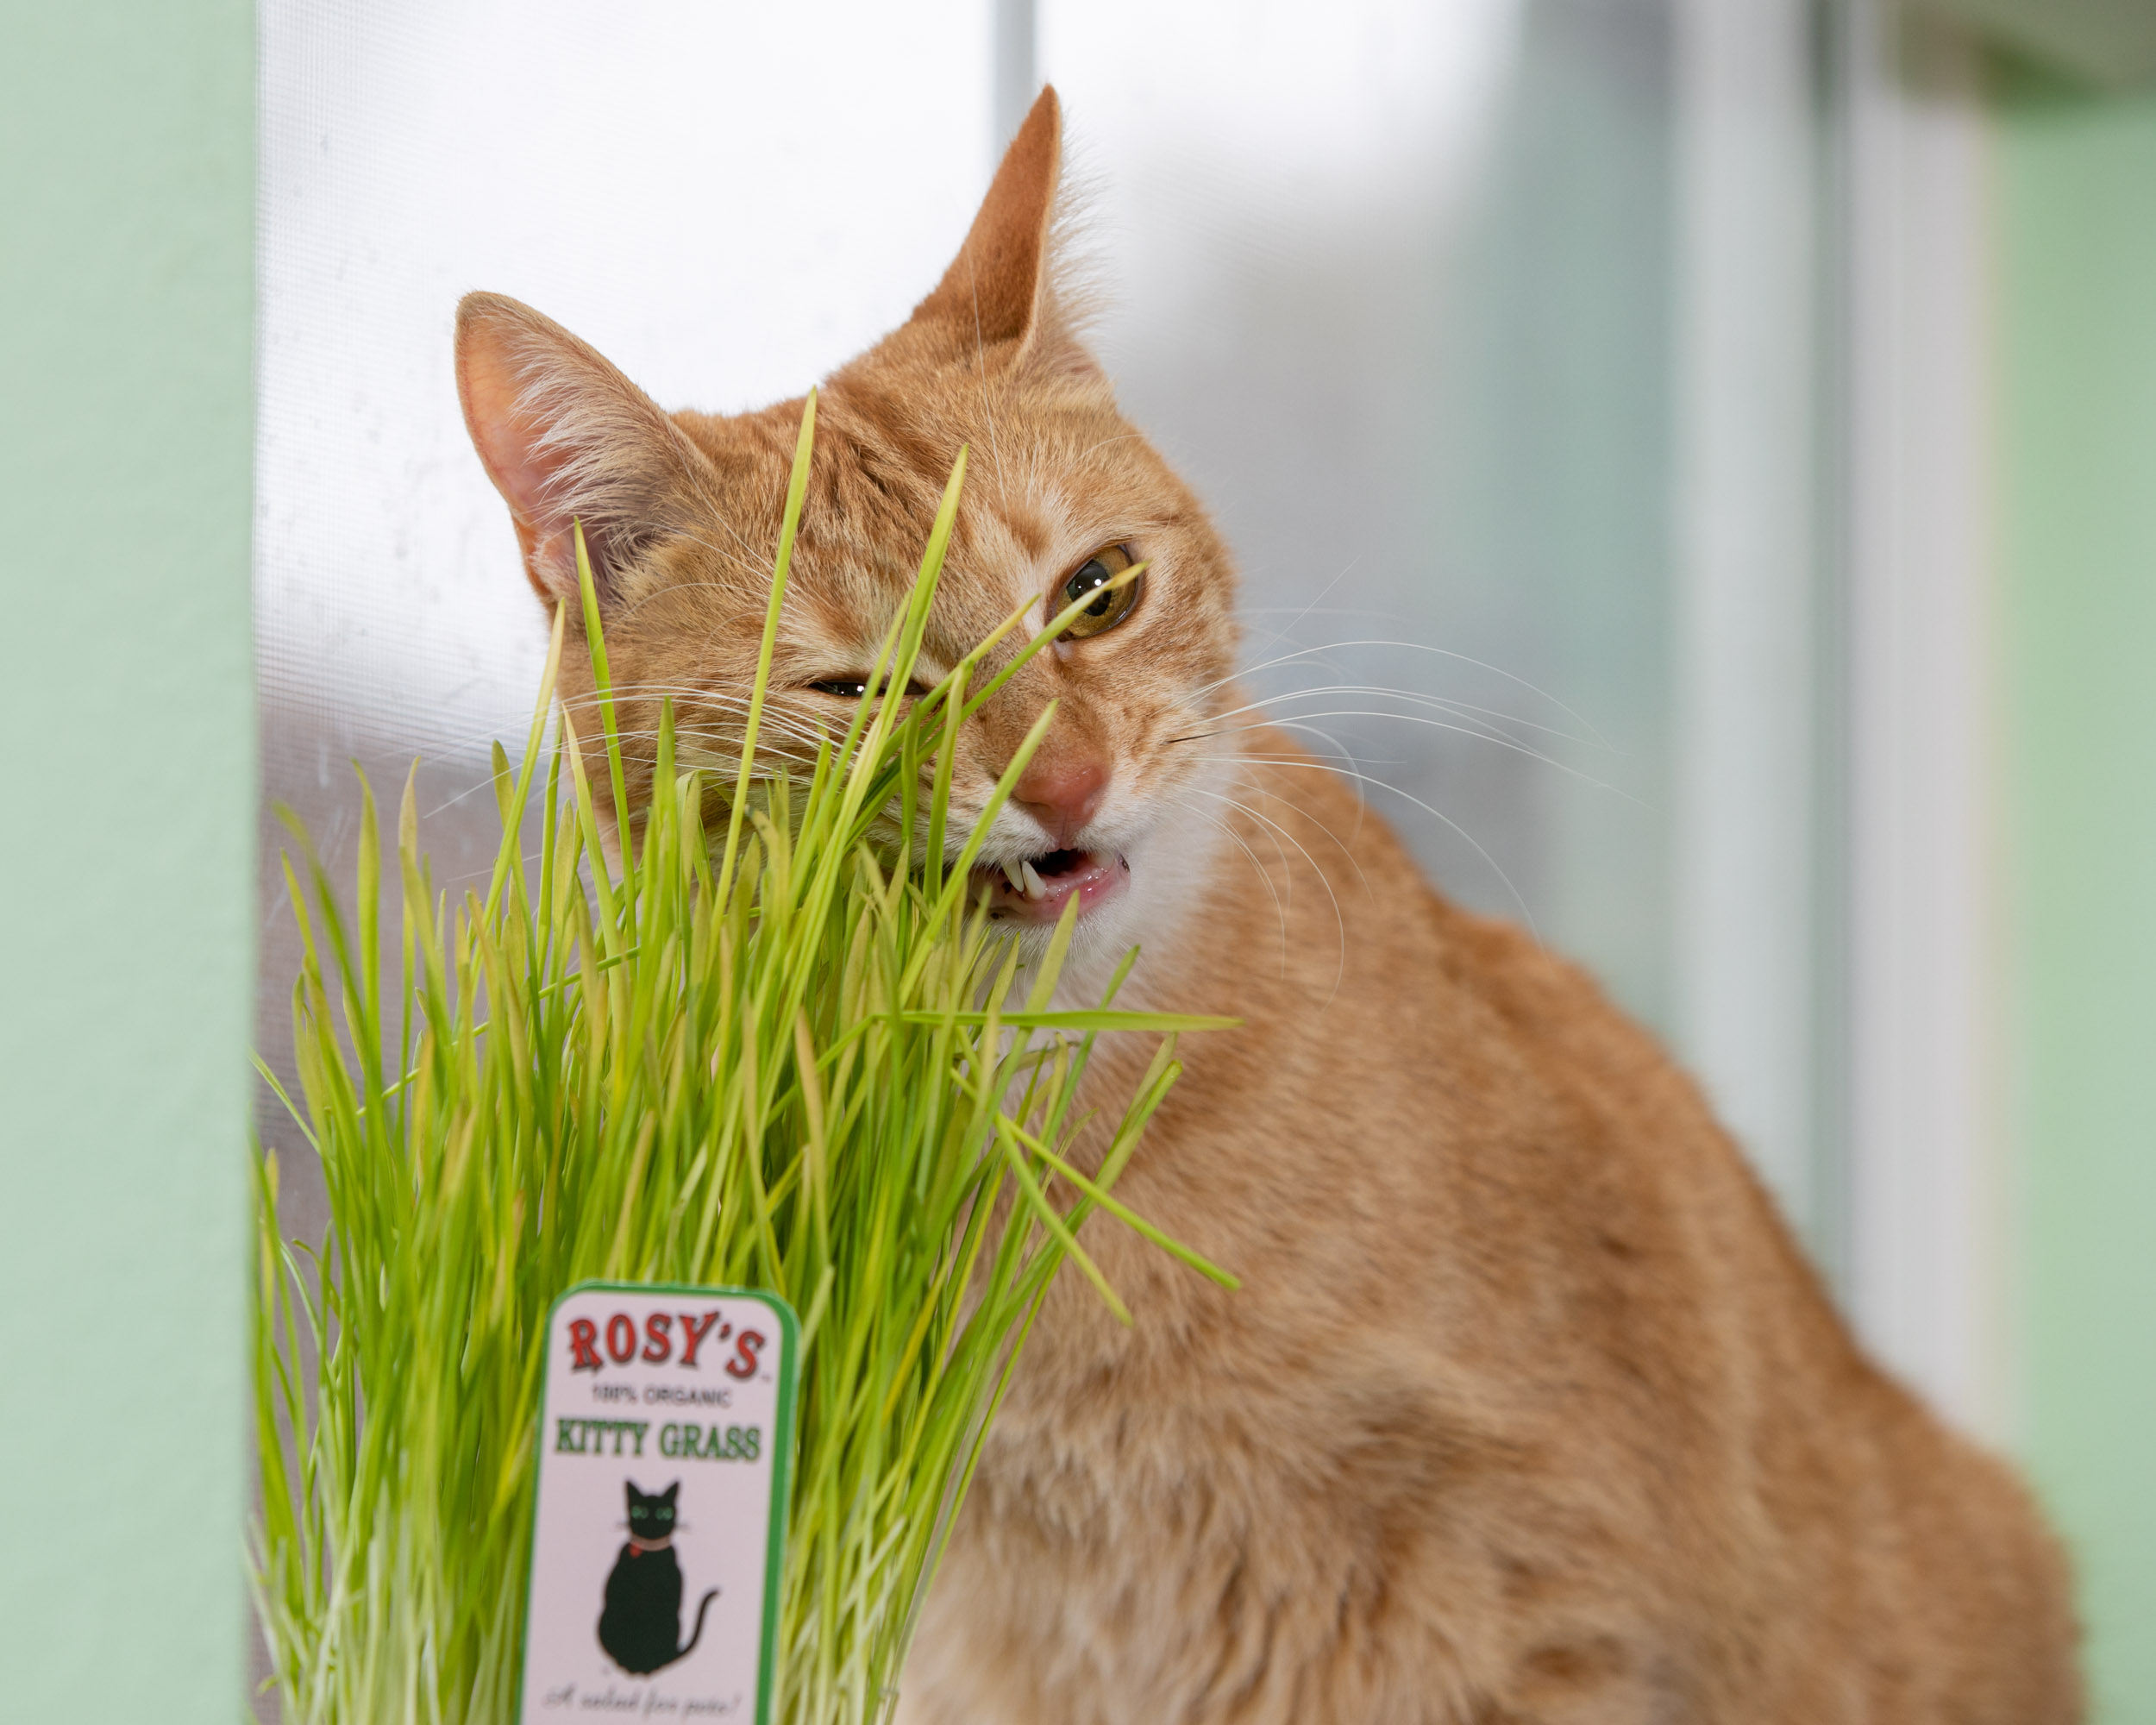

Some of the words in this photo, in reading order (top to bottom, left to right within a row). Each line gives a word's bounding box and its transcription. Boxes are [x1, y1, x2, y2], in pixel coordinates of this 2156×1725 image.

[568, 1309, 767, 1380] ROSY'S
[642, 1387, 732, 1408] ORGANIC
[555, 1417, 649, 1457] KITTY
[659, 1422, 761, 1462] GRASS
